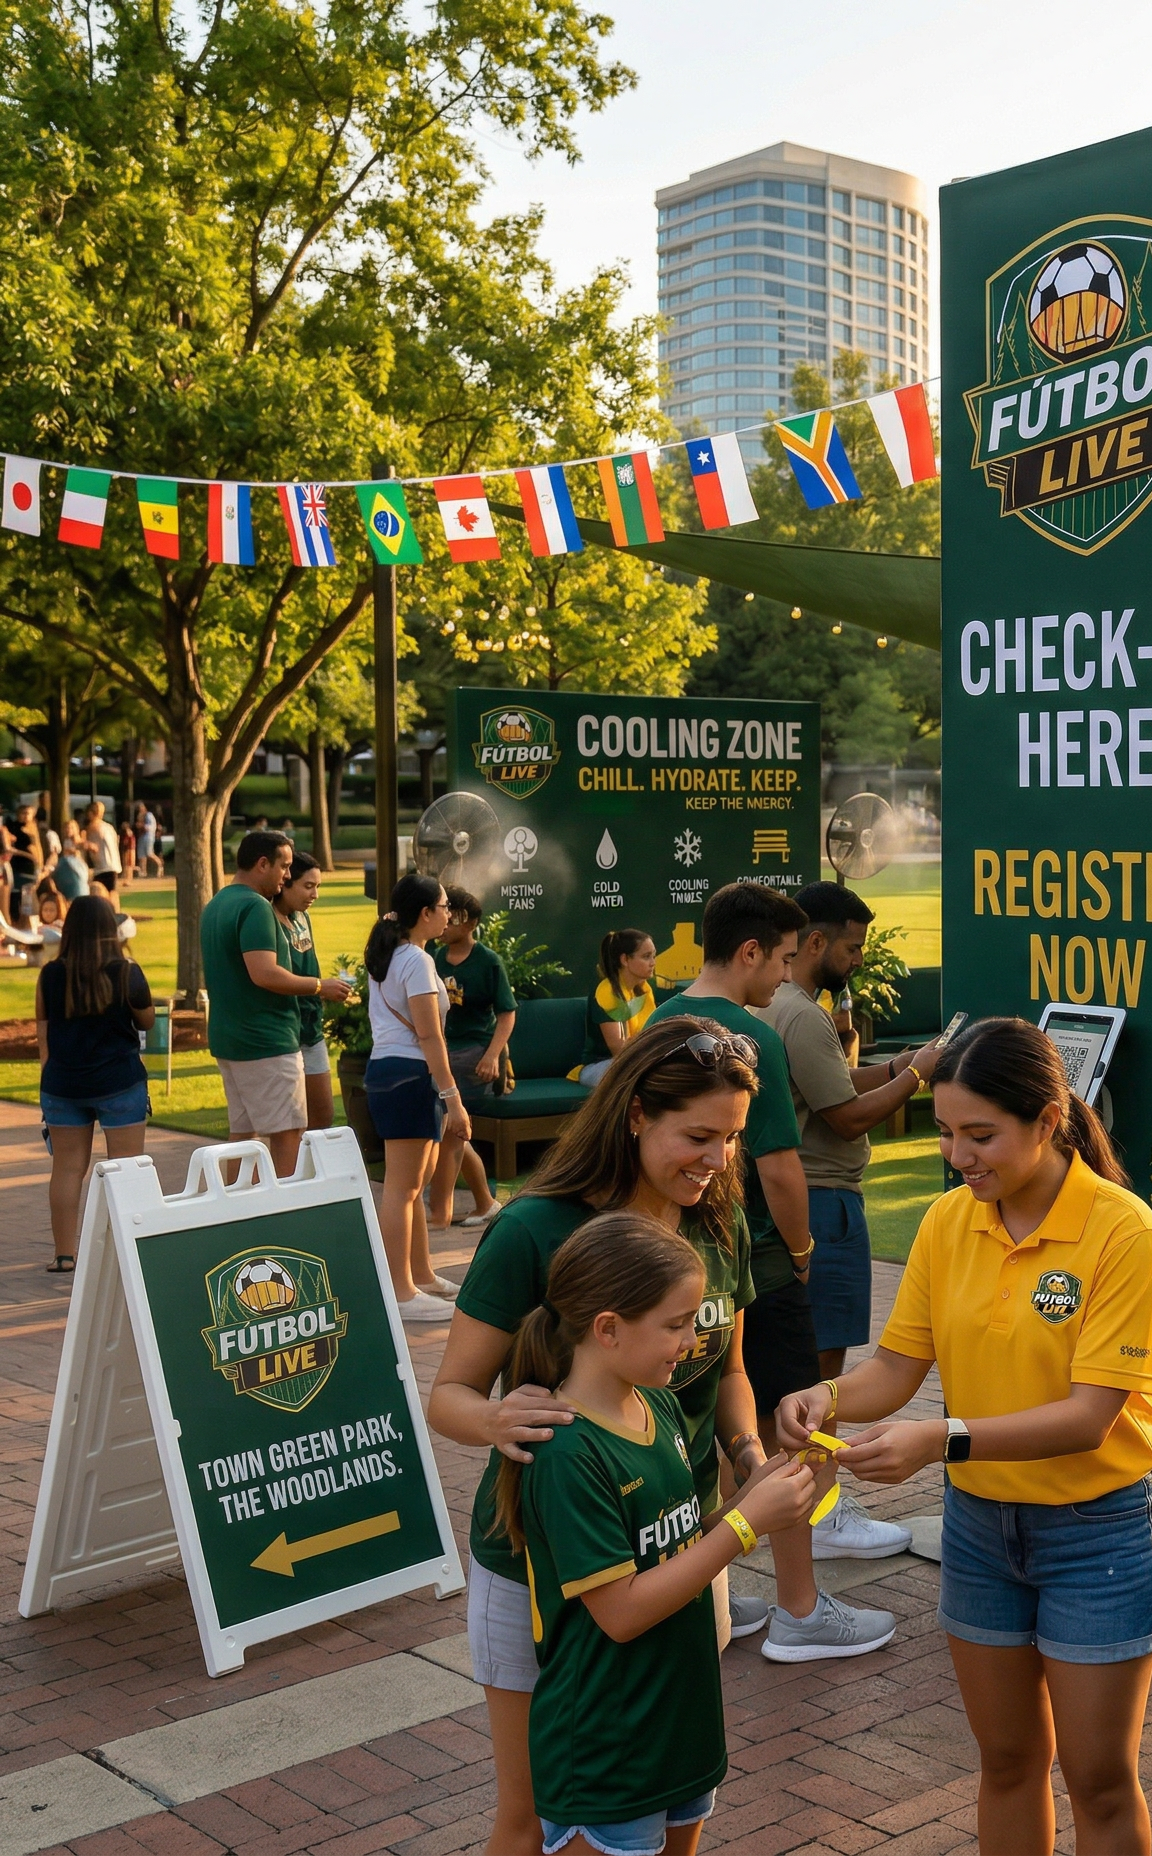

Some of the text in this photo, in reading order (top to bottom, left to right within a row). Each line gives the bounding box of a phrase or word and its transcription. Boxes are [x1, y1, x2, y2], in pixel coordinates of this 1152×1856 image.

[1039, 419, 1149, 494] LIVE
[480, 743, 553, 764] FÚTBOL
[577, 714, 803, 760] COOLING ZONE
[500, 765, 539, 780] LIVE
[578, 767, 802, 792] CHILL. HYDRATE. KEEP.
[685, 797, 717, 810] KEEP
[720, 797, 744, 810] THE
[509, 898, 535, 910] FANS
[668, 879, 709, 891] COOLING
[1029, 934, 1147, 1009] NOW
[259, 1344, 317, 1383] LIVE
[198, 1413, 404, 1491] TOWN GREEN PARK,
[218, 1450, 403, 1524] THE WOODLANDS.
[639, 1494, 701, 1557] FÚTBO
